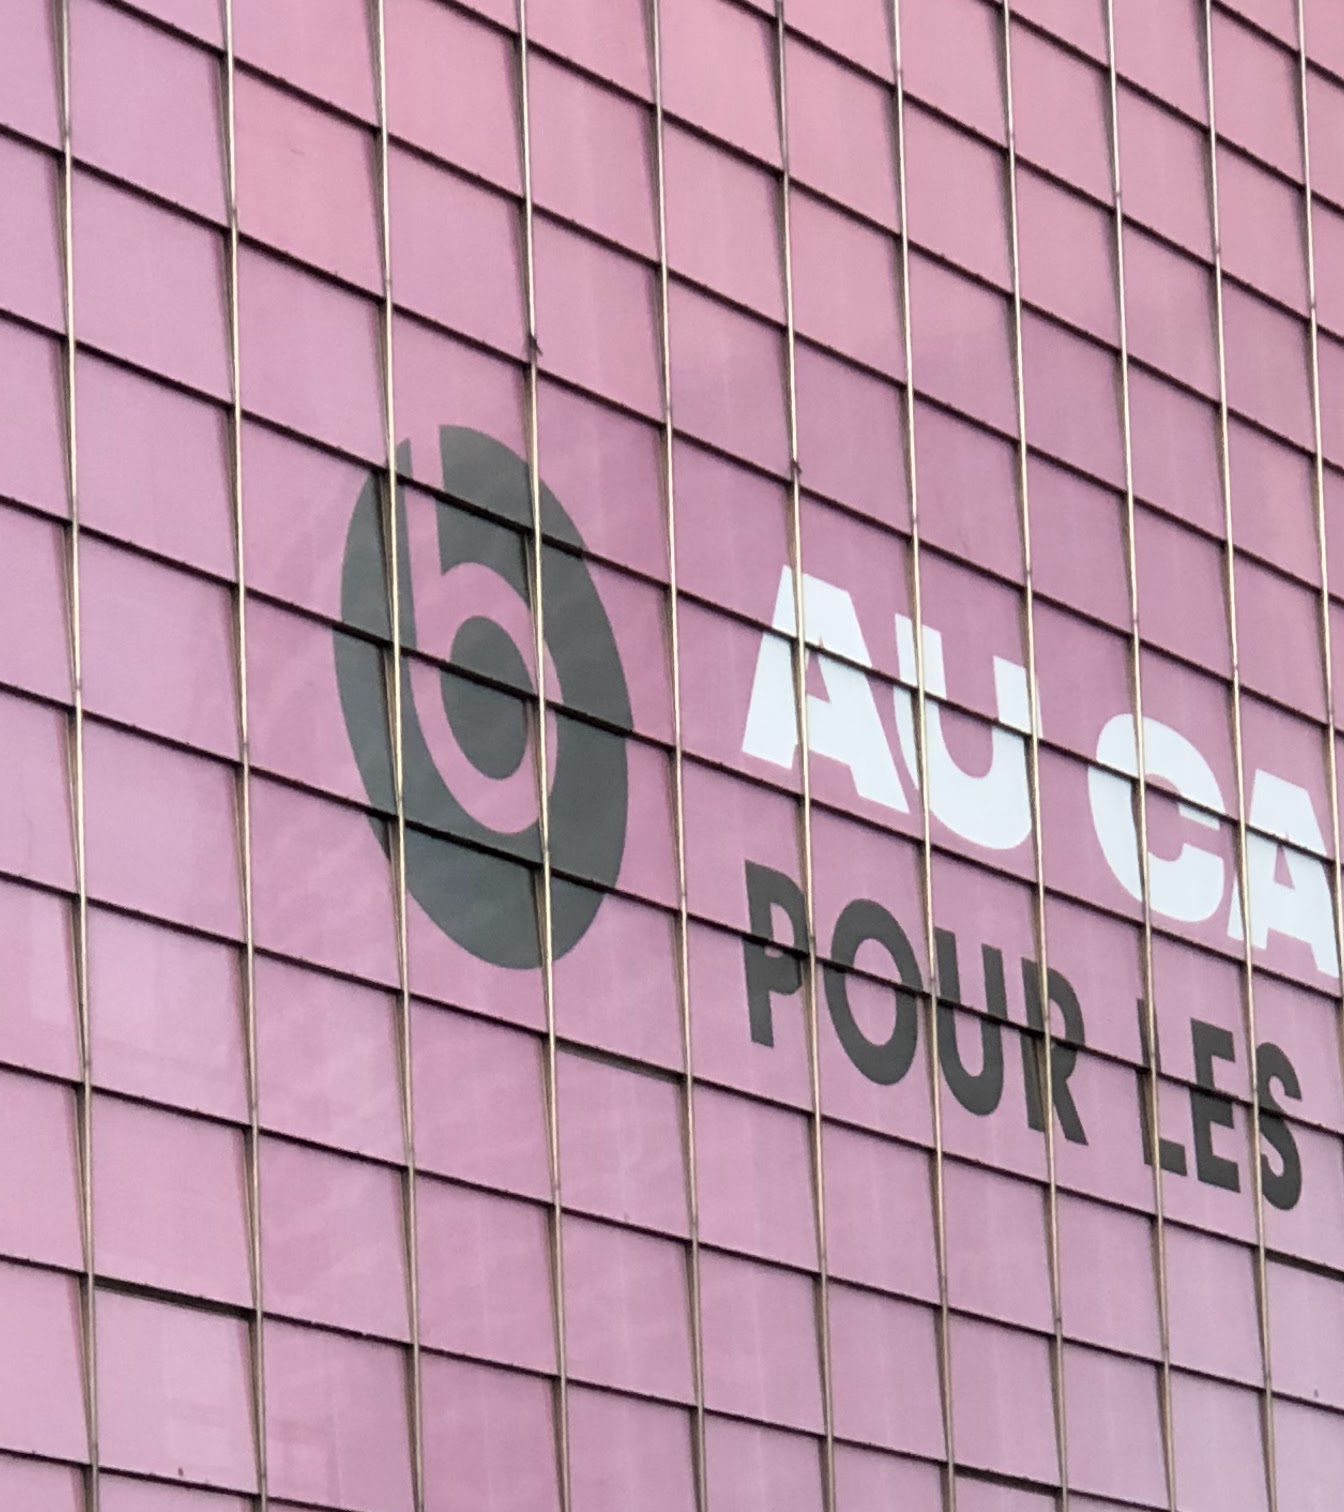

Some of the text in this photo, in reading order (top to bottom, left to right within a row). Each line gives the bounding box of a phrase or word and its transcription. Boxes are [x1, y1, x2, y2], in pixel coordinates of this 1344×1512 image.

[741, 564, 1044, 849] AU
[740, 859, 1089, 1146] POUR
[1137, 998, 1303, 1211] LES
